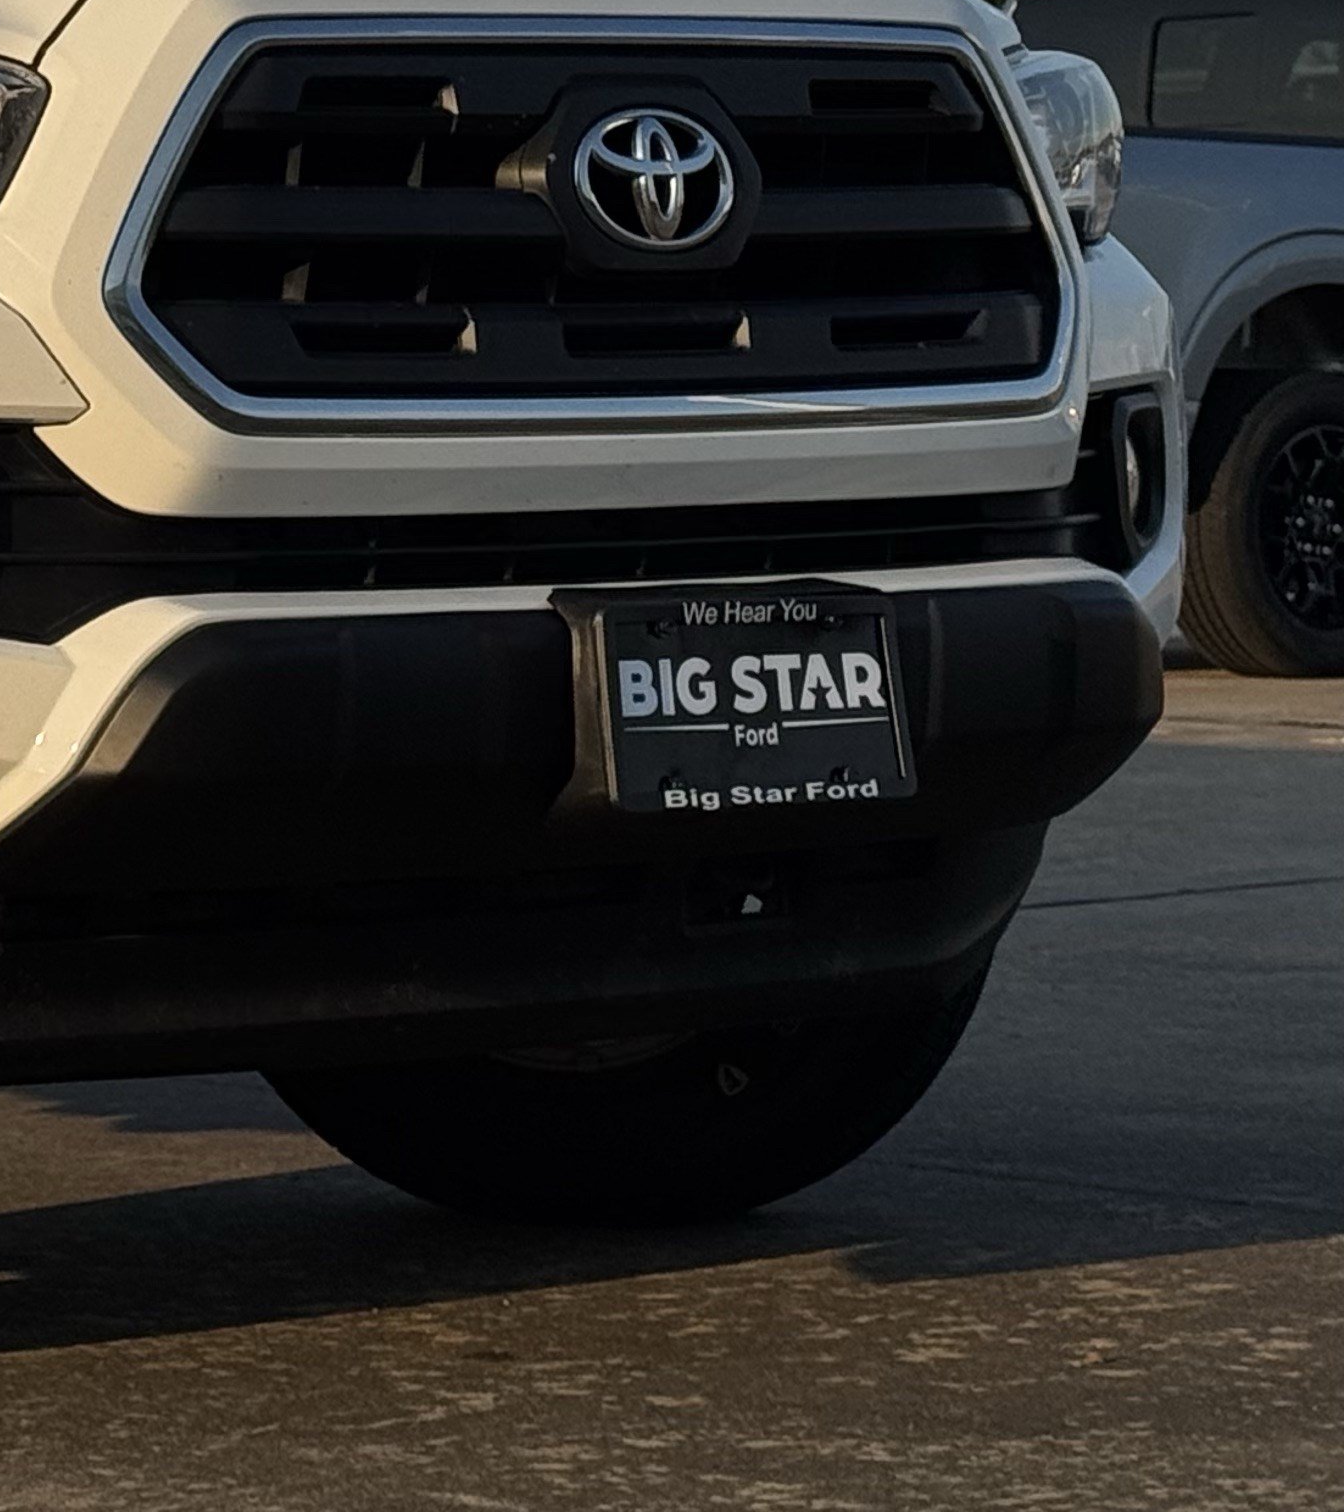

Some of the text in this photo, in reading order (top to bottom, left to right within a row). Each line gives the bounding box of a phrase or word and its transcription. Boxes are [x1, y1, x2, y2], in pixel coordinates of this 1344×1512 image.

[682, 598, 817, 626] We Hear You
[618, 651, 888, 718] BIG STAR
[733, 722, 780, 747] Ford
[664, 778, 879, 811] Big Star Ford
